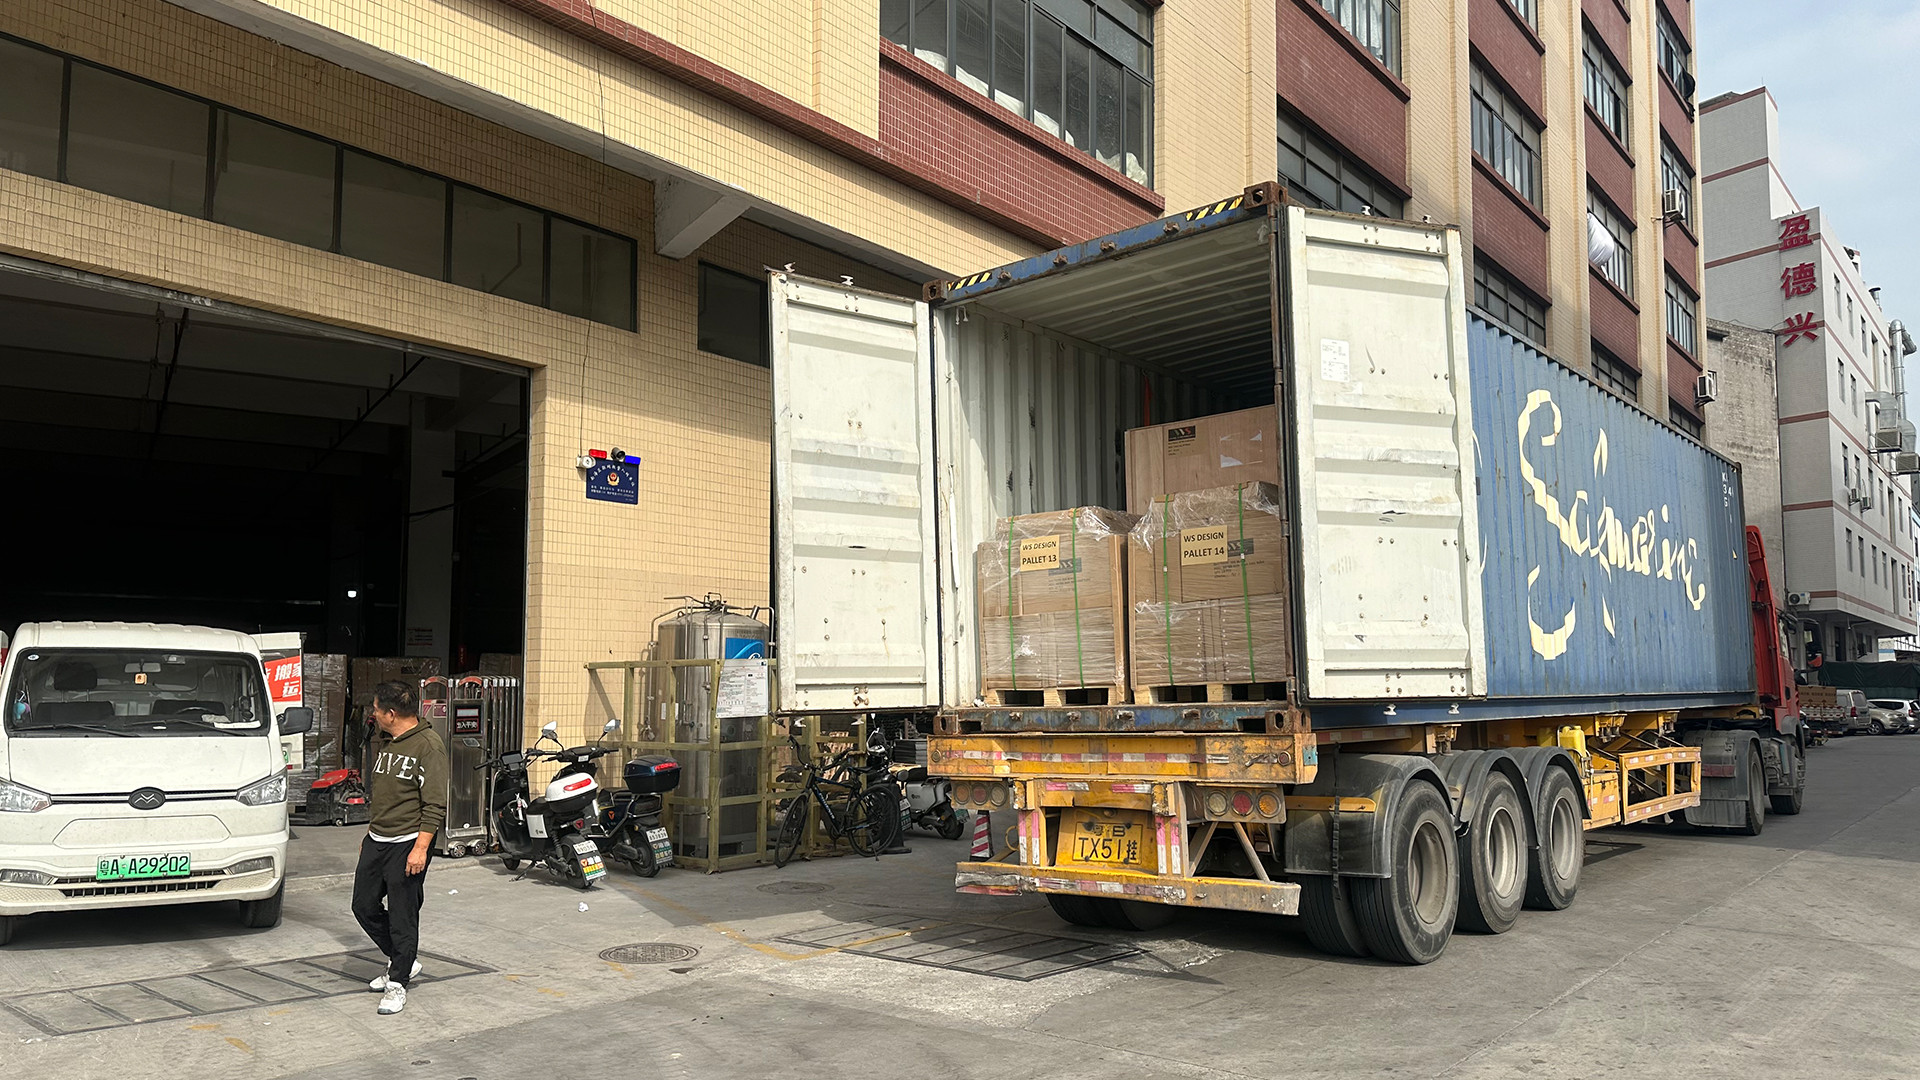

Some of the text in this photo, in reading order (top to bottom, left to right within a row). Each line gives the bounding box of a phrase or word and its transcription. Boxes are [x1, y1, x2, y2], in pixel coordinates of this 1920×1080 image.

[1778, 214, 1818, 347] 盈德兴
[1196, 532, 1224, 541] DESIGN
[1033, 541, 1057, 549] DESIGN
[1183, 547, 1225, 558] PALLET 14
[1022, 556, 1046, 564] PALLET
[128, 855, 189, 875] A29202
